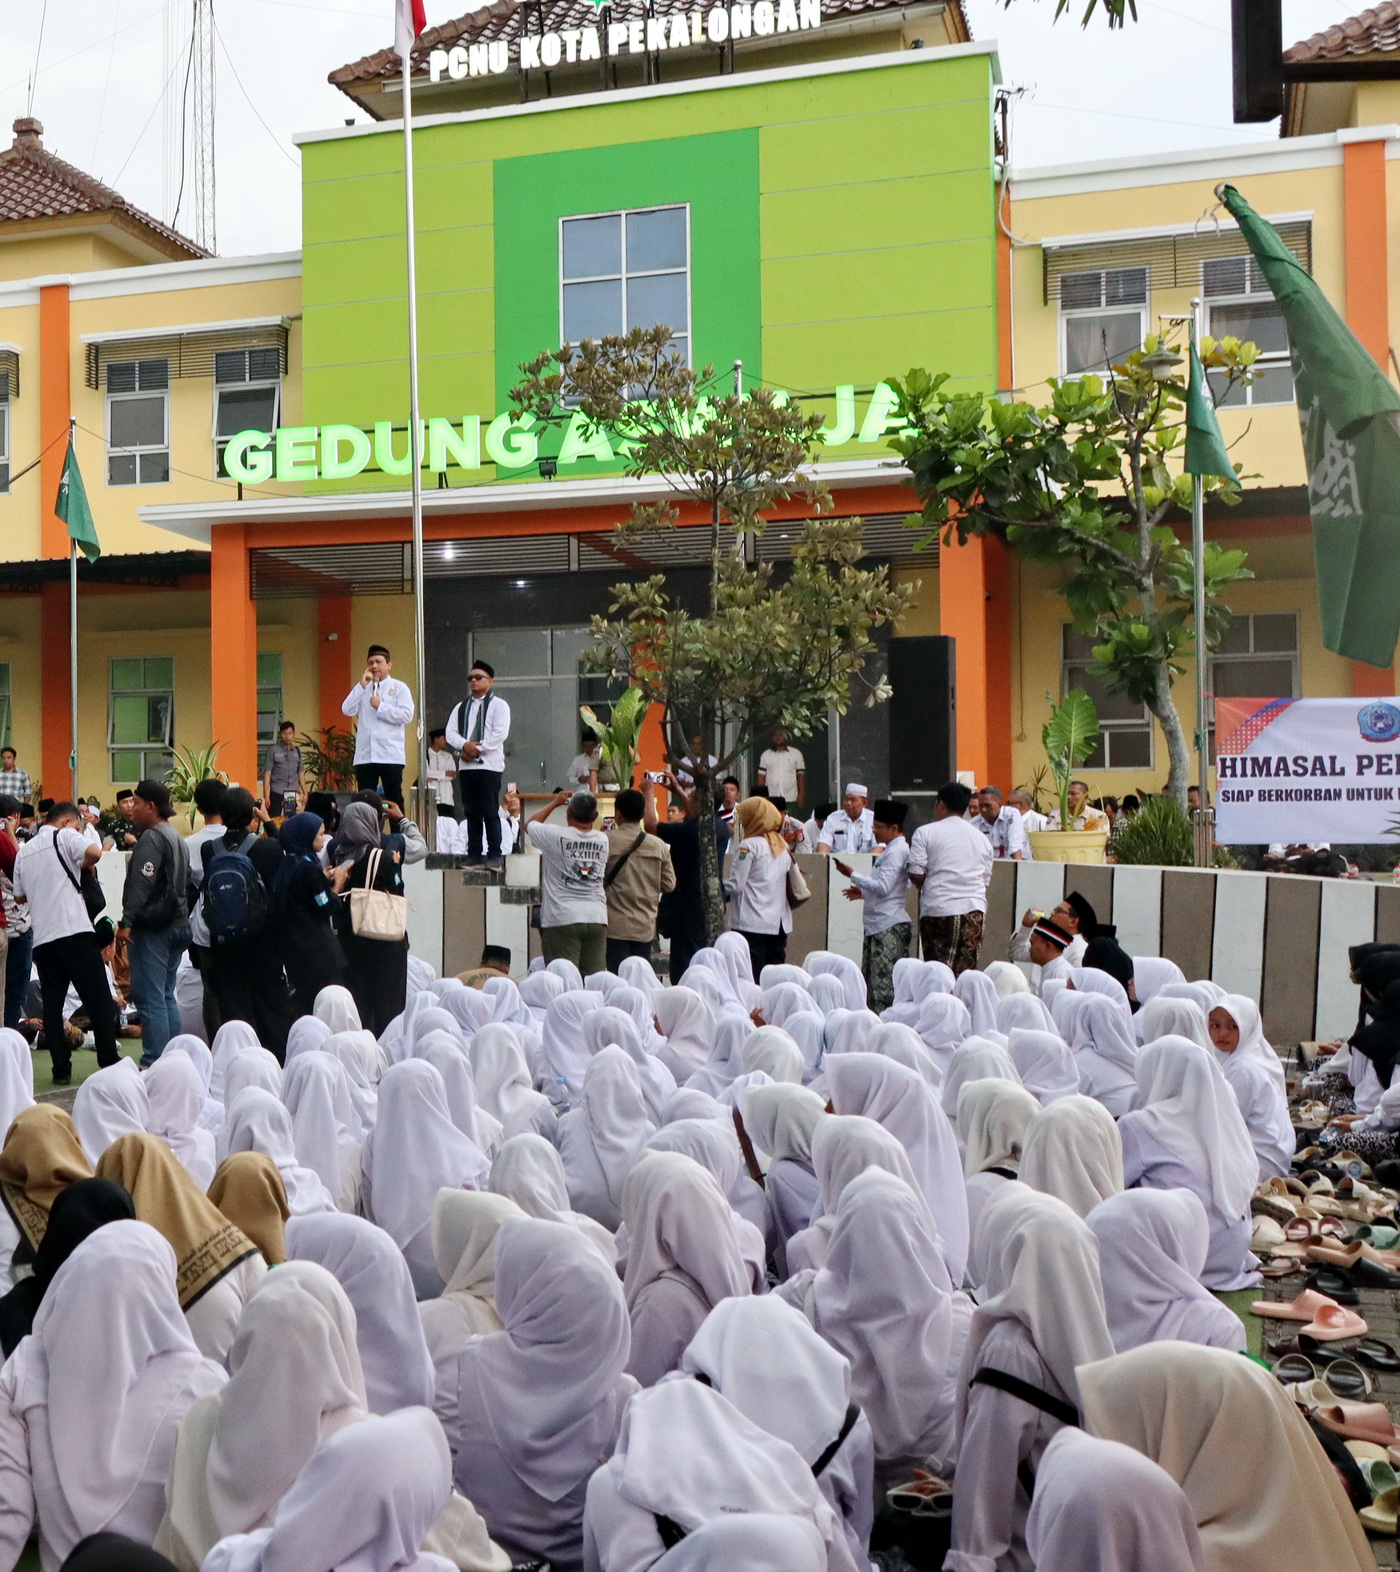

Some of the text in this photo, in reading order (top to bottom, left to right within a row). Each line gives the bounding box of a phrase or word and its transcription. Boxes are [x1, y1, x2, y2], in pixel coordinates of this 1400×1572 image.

[429, 0, 821, 83] PCNU KOTA PEKALONGAN
[224, 410, 538, 485] GEDUNG
[1219, 755, 1345, 778] HIMASAL
[1221, 787, 1394, 803] SIAP BERKORBAN UNTUK
